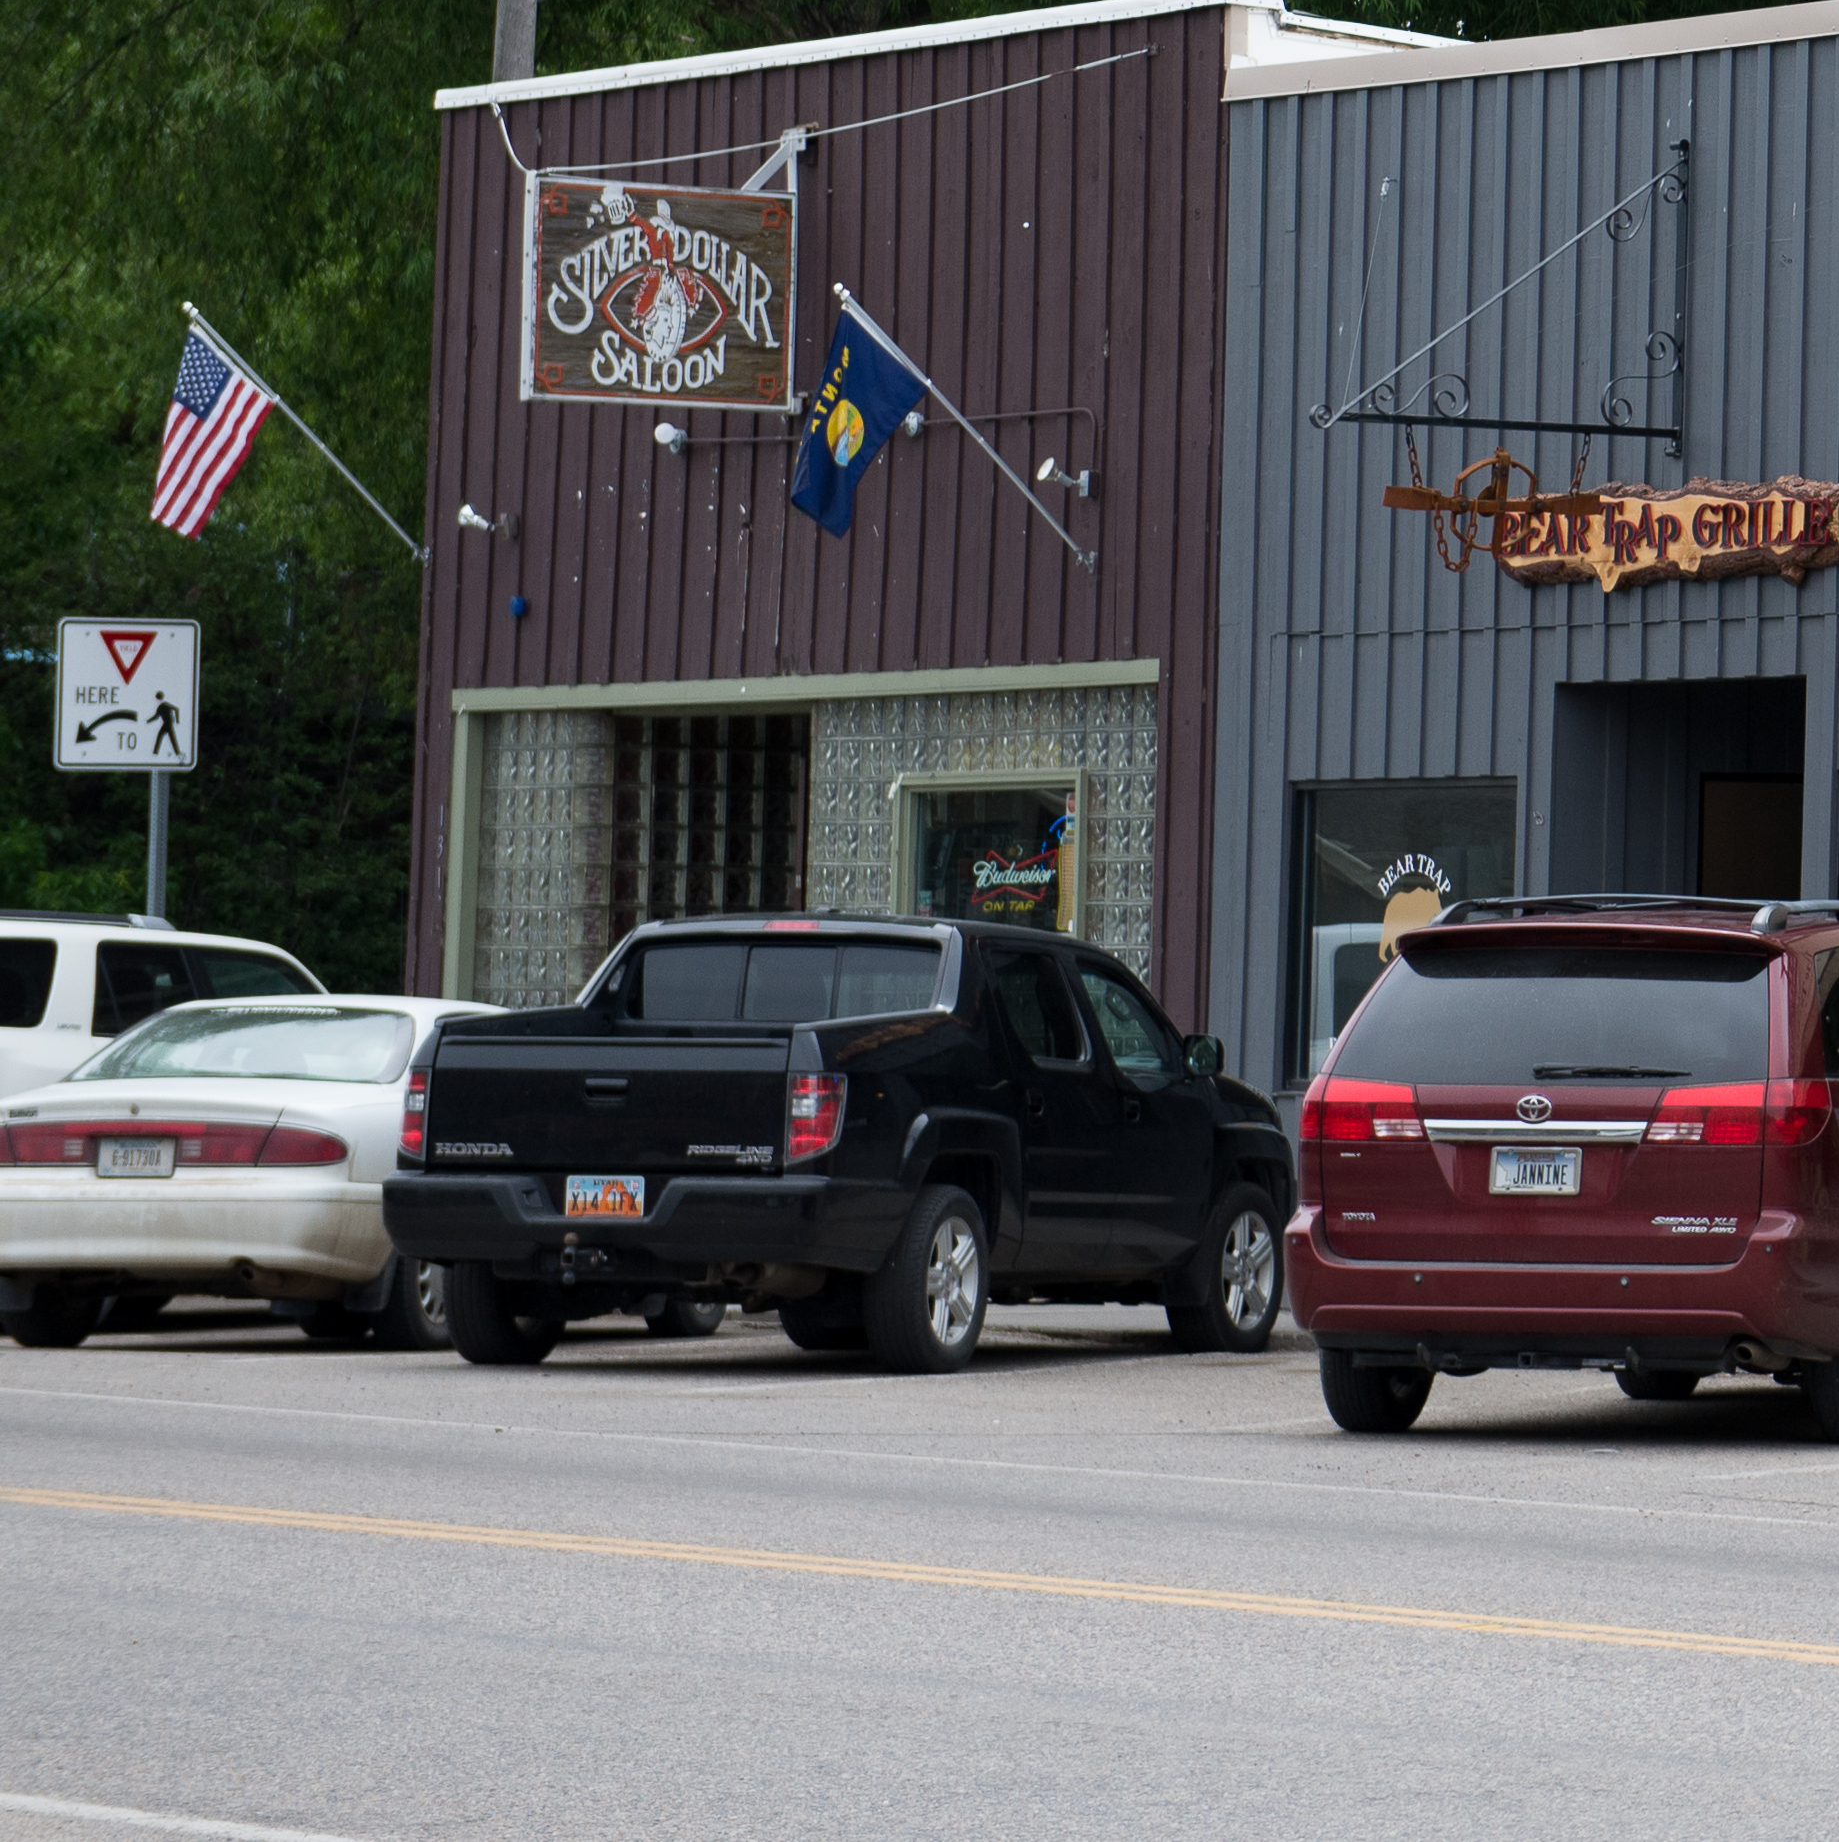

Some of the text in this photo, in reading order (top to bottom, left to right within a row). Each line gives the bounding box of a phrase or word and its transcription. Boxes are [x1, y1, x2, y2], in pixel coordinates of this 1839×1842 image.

[547, 223, 781, 349] SILVER DOLLAR
[591, 329, 727, 393] SALOON
[1500, 497, 1832, 566] BEAR TRAP GRILLE
[75, 686, 120, 704] HERE
[117, 732, 137, 750] TO
[973, 860, 1056, 888] Budweiser
[1377, 853, 1451, 897] BEAR TRAP
[983, 900, 1035, 913] ON TAP
[435, 1142, 514, 1157] HONDA
[687, 1144, 774, 1157] RIDGELINE
[1513, 1164, 1567, 1185] JANNINE
[1342, 1212, 1376, 1221] TOYOTA
[1650, 1215, 1738, 1226] SIENNA XLE
[1671, 1225, 1707, 1233] LIMITED
